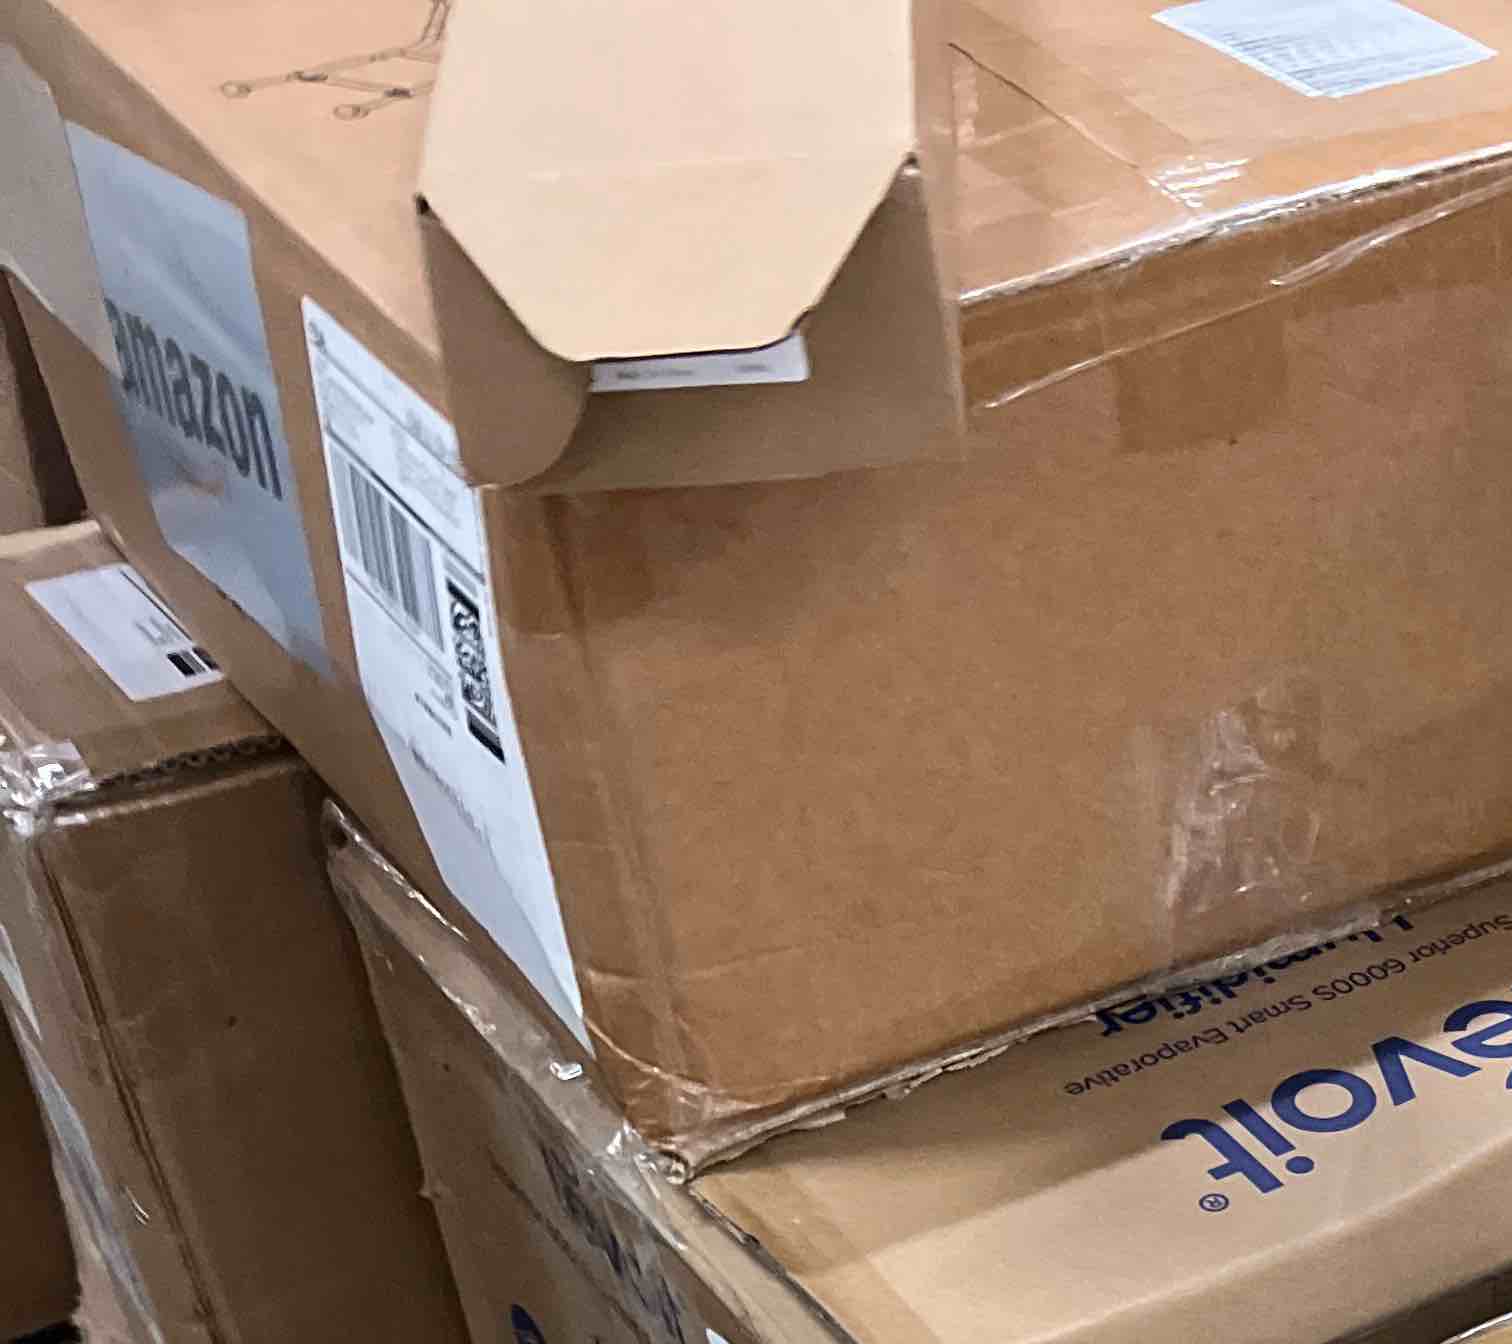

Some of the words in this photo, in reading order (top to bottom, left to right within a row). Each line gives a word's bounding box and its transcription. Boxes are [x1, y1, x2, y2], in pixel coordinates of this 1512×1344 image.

[103, 297, 283, 501] amazon
[1311, 956, 1406, 1000] 6000S
[1227, 994, 1312, 1035] Smart
[1064, 1026, 1229, 1096] Evaporative
